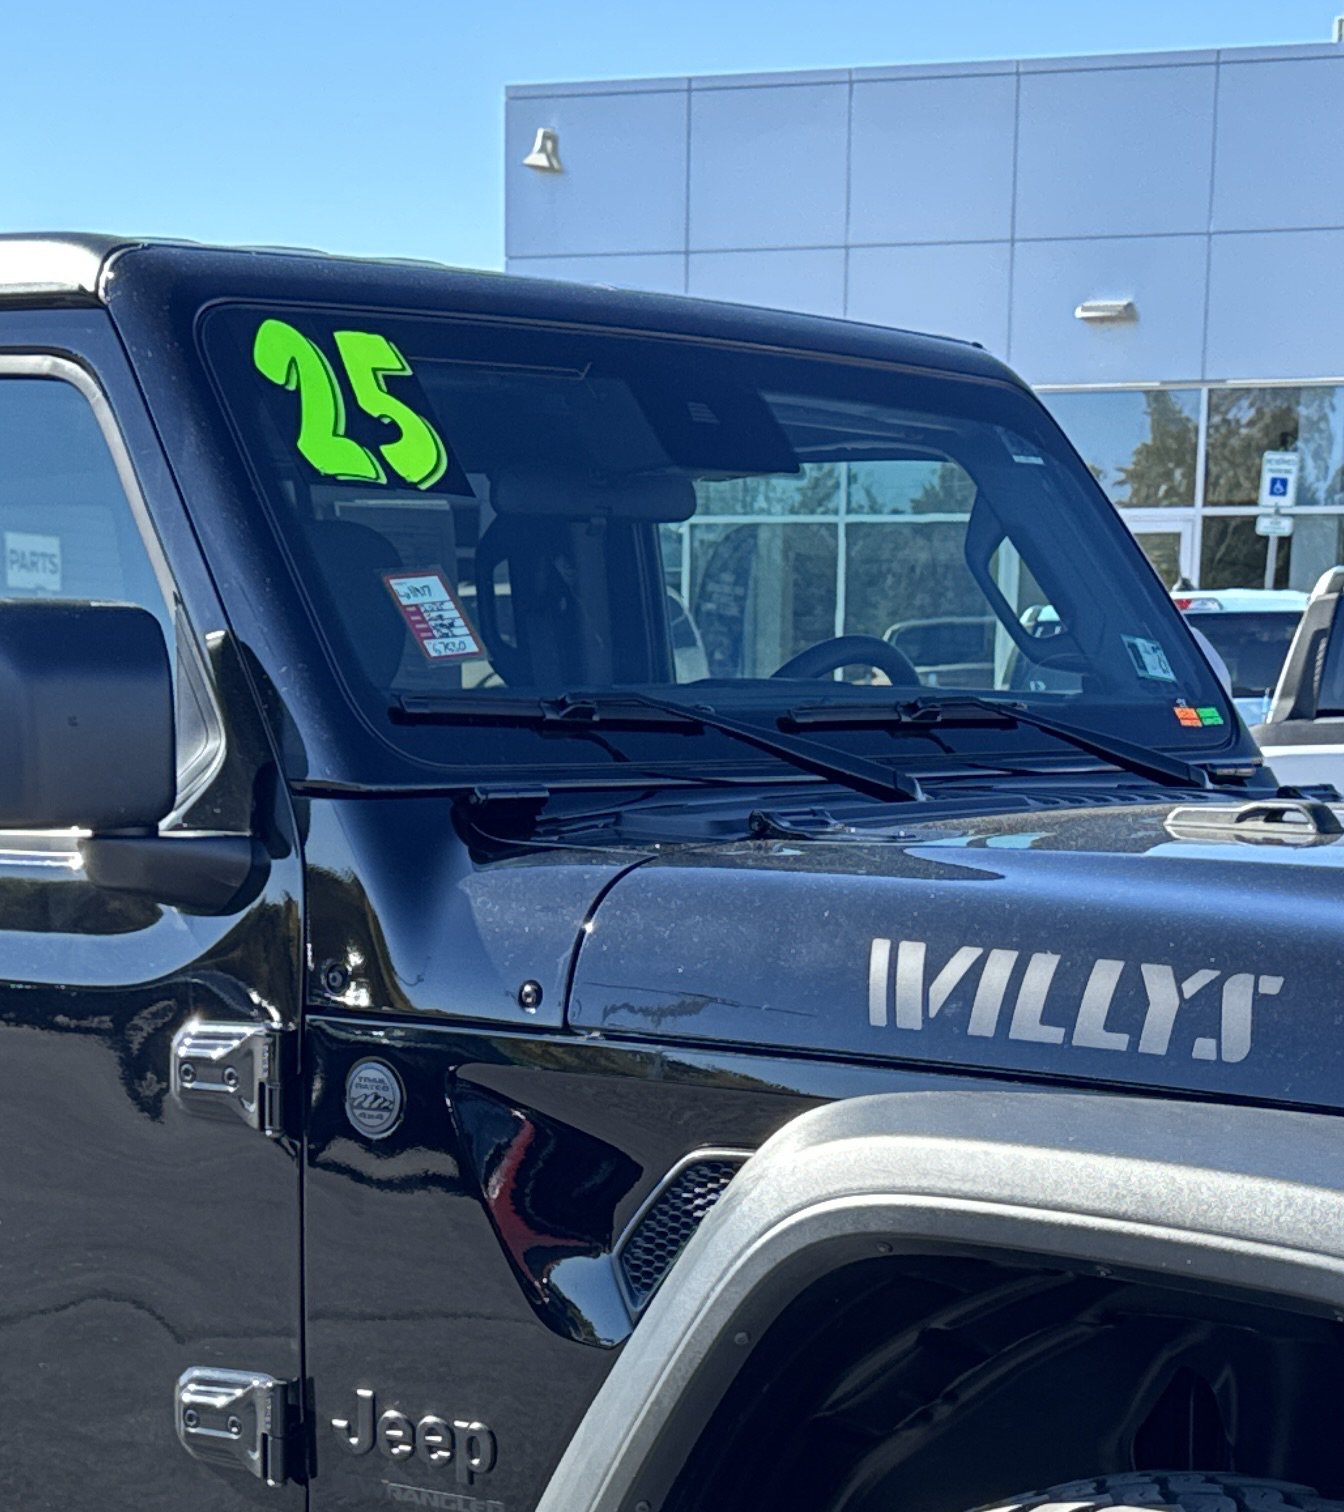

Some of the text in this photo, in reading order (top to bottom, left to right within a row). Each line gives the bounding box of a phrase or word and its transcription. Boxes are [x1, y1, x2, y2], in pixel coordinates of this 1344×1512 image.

[253, 318, 449, 491] 25
[8, 548, 59, 575] PARTS
[868, 937, 1285, 1063] WILLYS
[331, 1388, 498, 1486] Jeep
